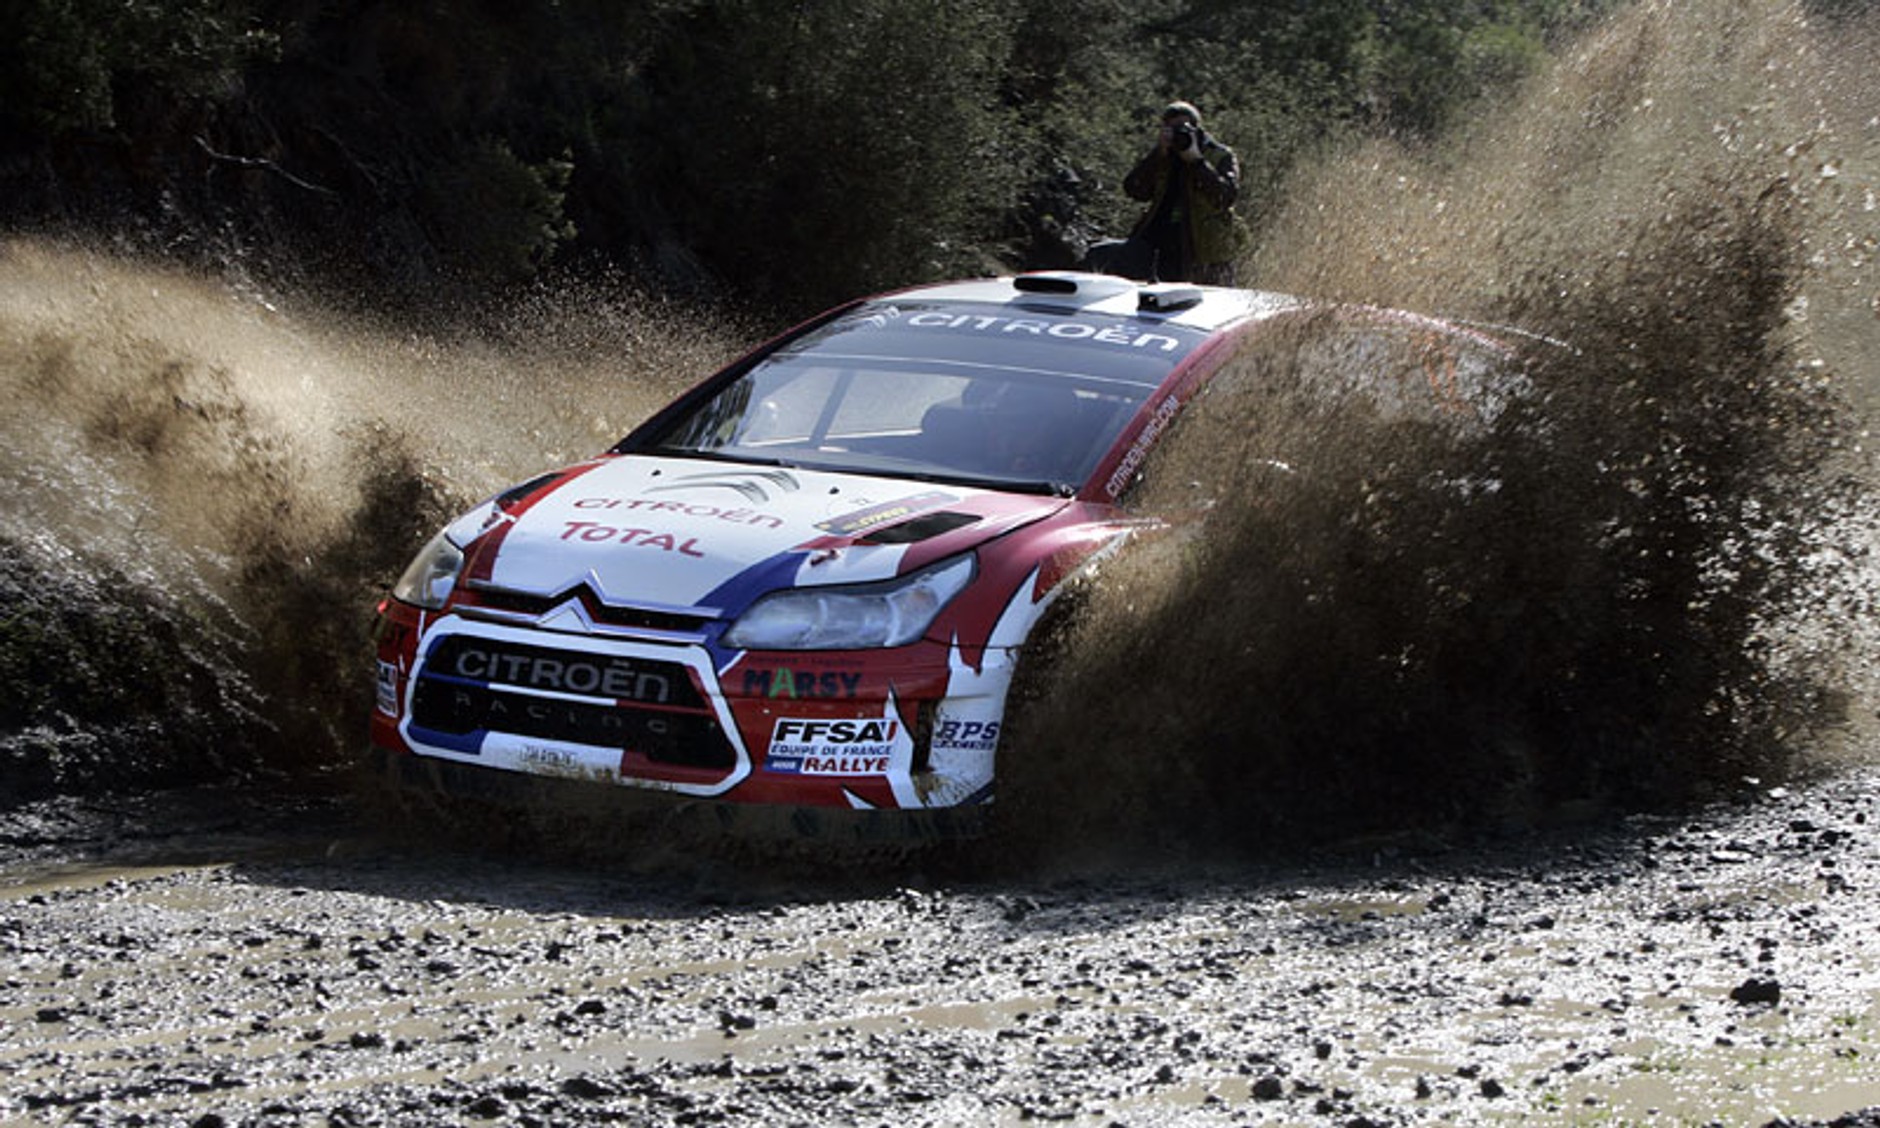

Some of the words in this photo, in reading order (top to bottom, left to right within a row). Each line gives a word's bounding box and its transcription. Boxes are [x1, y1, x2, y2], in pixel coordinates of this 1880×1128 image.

[560, 521, 704, 558] TOTAL
[743, 667, 862, 698] MARSY
[775, 721, 884, 743] FFSA
[937, 721, 1000, 740] BPS
[821, 745, 839, 755] DE
[842, 745, 892, 755] FRANCE
[804, 757, 889, 772] RALLYE
